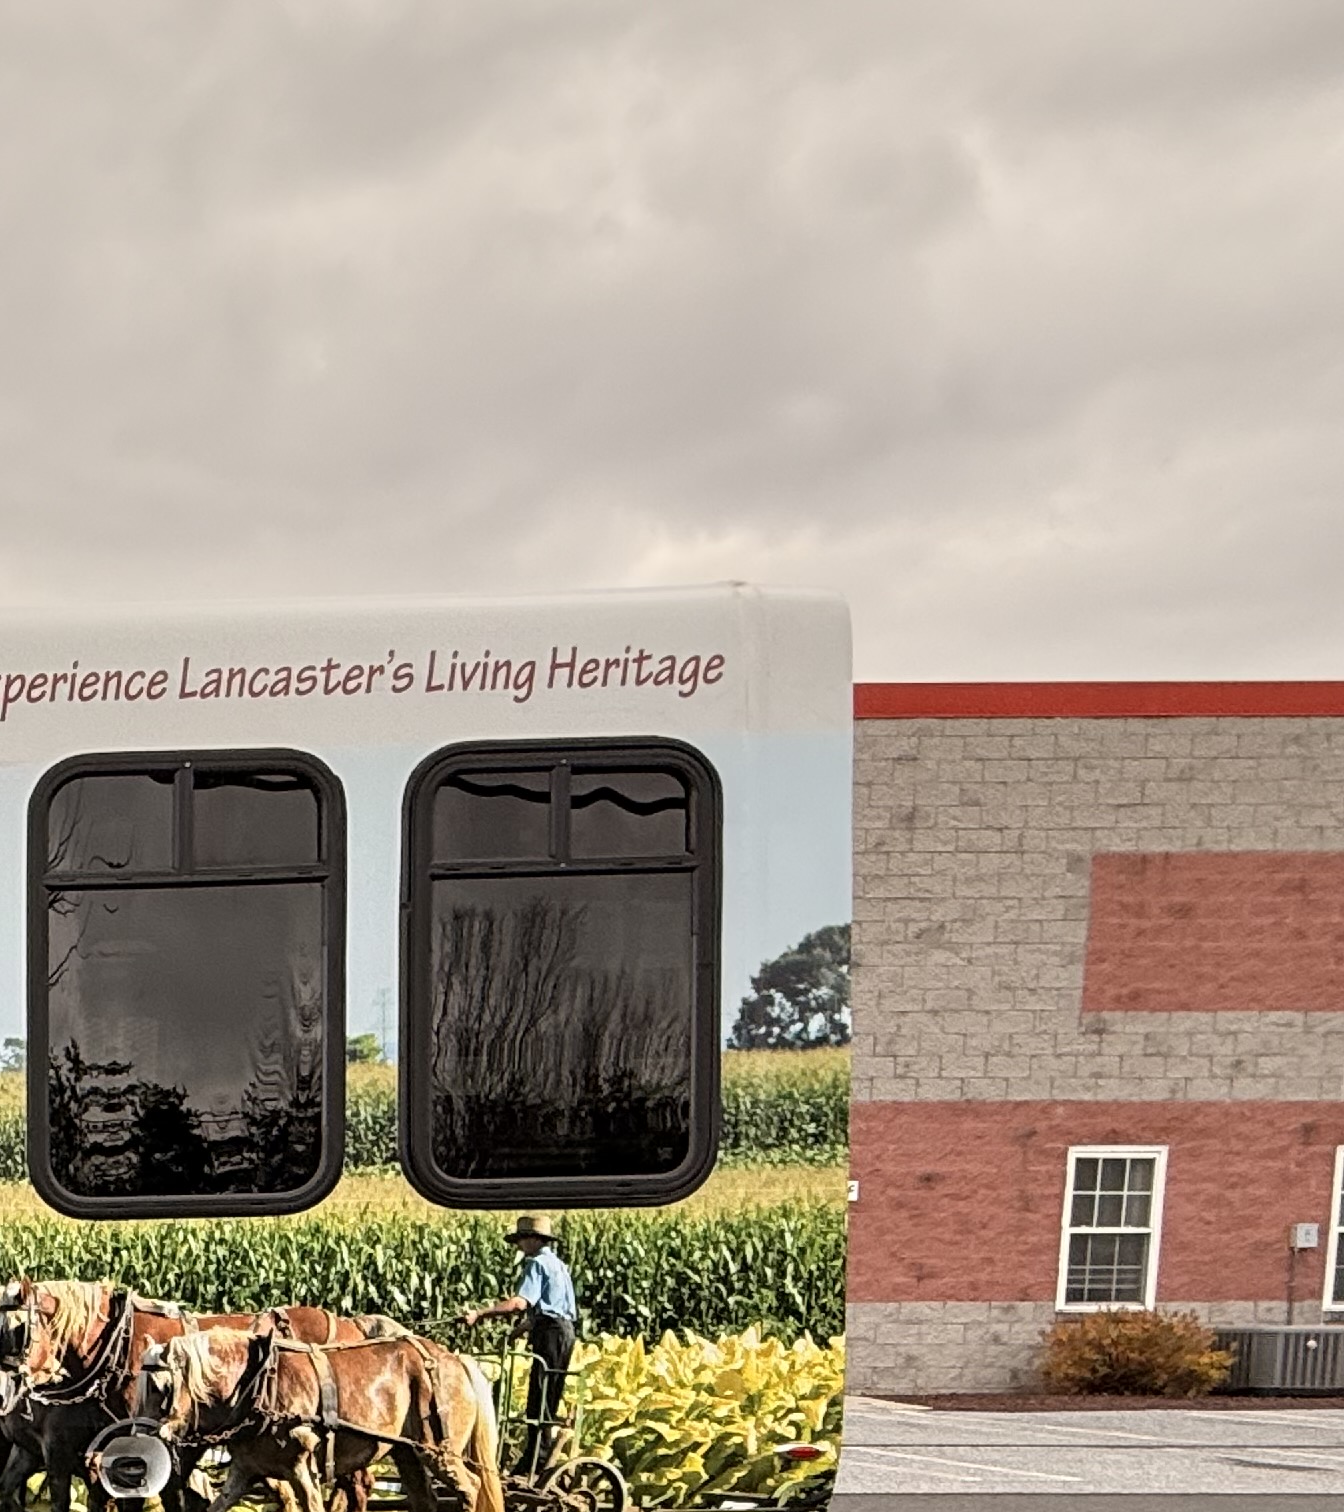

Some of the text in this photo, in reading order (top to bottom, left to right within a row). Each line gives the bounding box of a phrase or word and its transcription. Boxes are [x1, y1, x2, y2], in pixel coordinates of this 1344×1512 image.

[179, 649, 414, 701] Lancaster's
[425, 649, 537, 703] Living
[547, 646, 725, 698] Heritage
